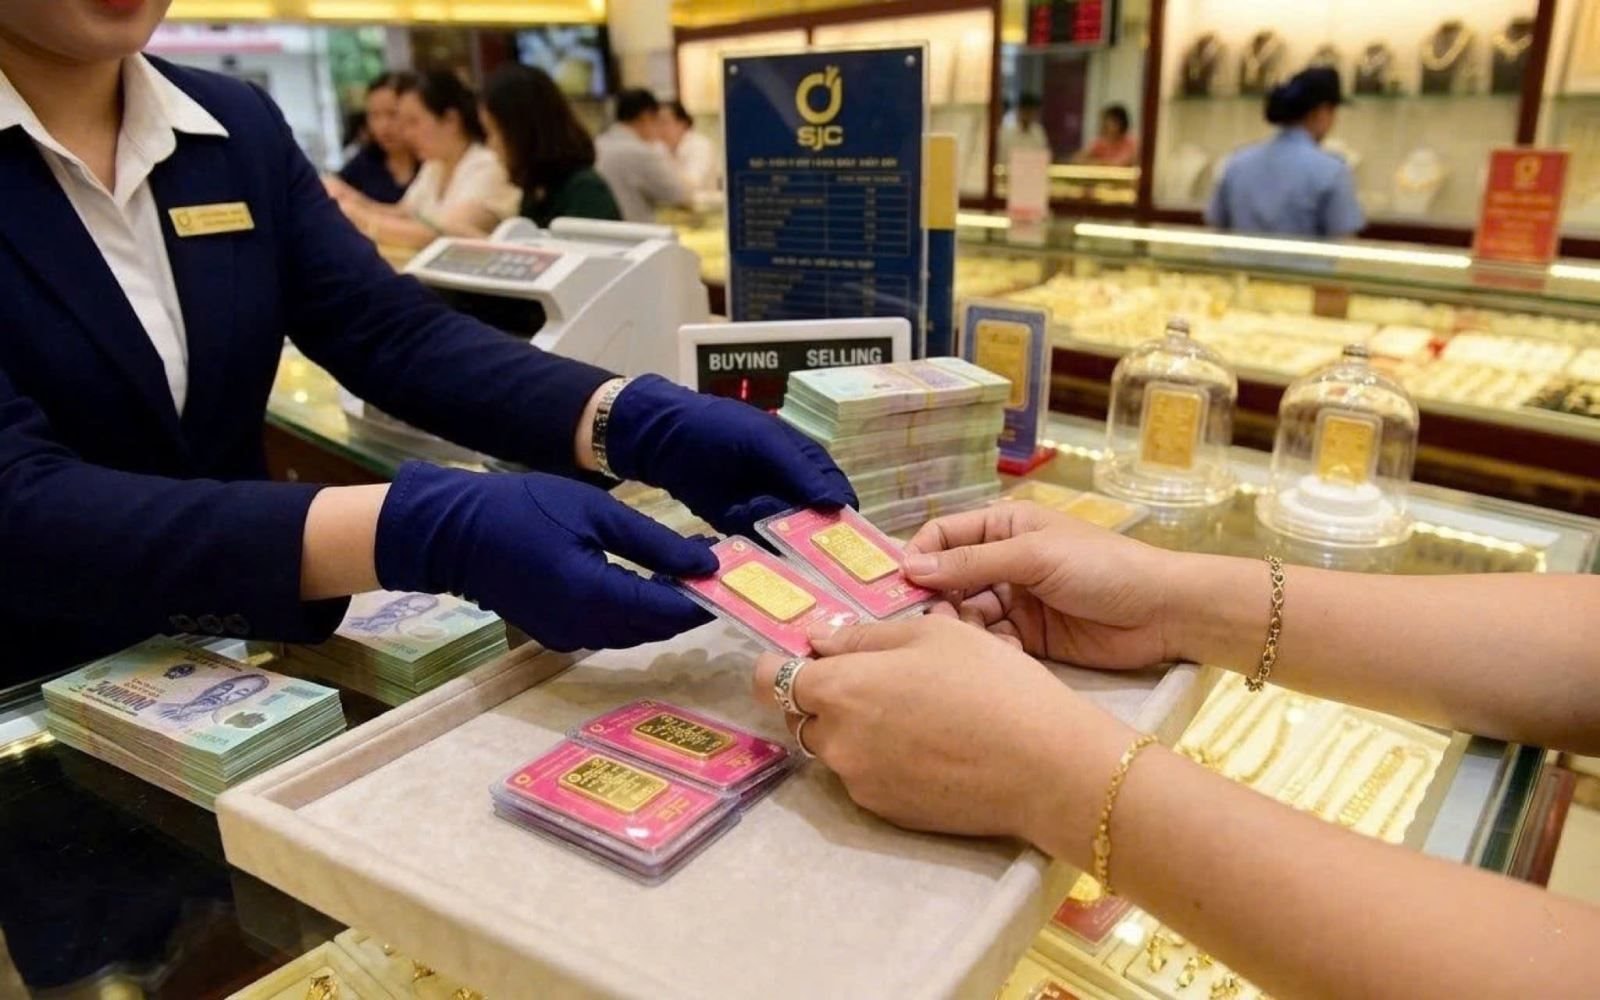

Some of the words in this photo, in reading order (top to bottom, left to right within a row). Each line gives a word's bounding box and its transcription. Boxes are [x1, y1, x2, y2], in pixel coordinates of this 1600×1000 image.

[797, 125, 843, 150] SJC
[708, 350, 779, 371] BUYING
[806, 347, 882, 367] SELLING
